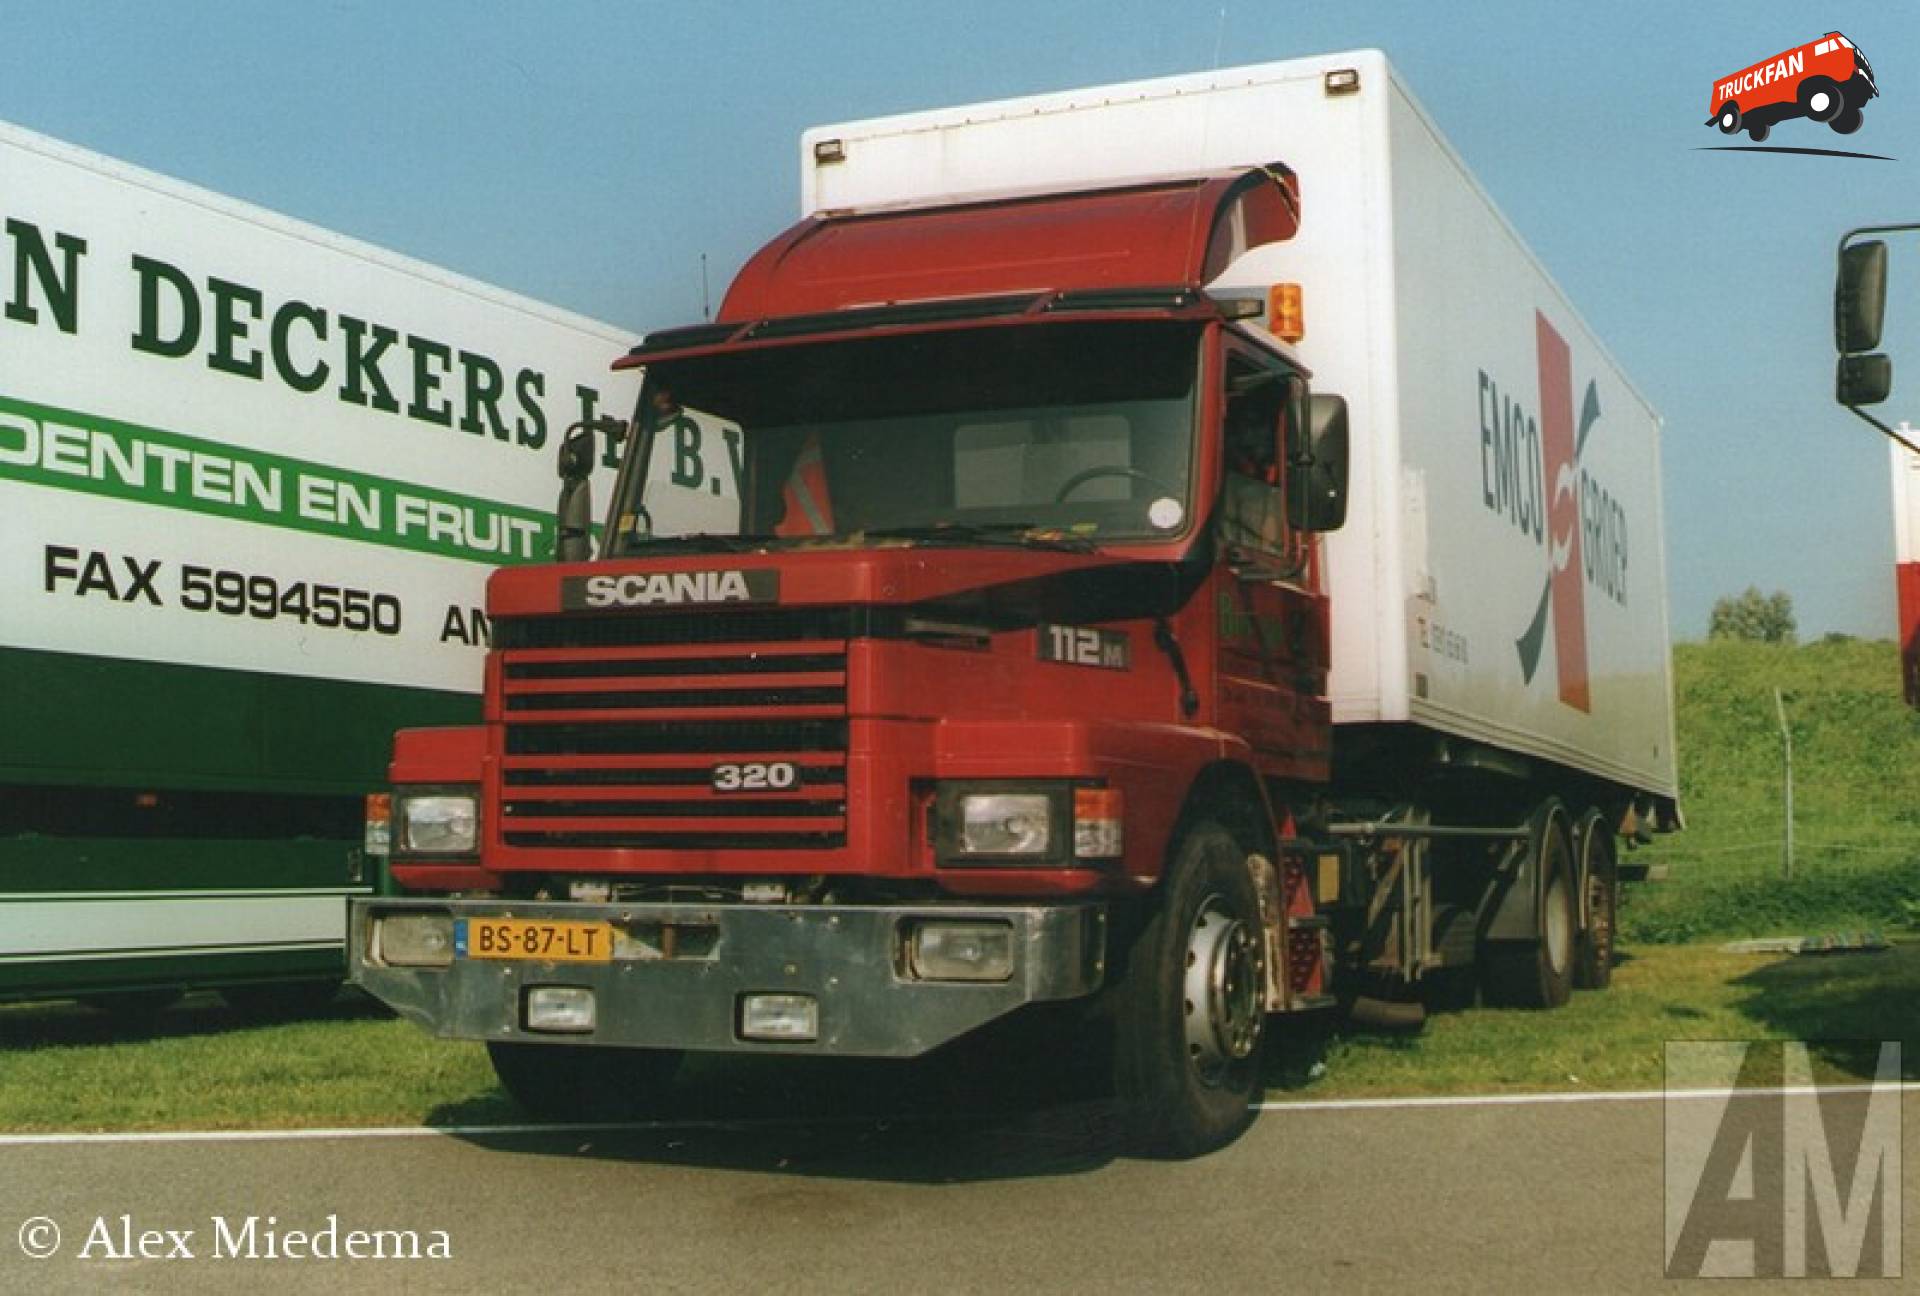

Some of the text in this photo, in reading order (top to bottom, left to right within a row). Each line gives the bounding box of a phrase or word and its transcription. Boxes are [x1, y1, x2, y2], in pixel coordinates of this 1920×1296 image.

[131, 253, 548, 450] DECKERS
[1478, 367, 1544, 545] EMCO
[298, 472, 381, 531] EN
[395, 497, 541, 559] FRUIT
[44, 544, 163, 606] FAX
[180, 565, 402, 636] 5994550
[586, 570, 750, 607] SCANIA
[712, 762, 795, 790] 320
[479, 925, 599, 957] BS-87-LT
